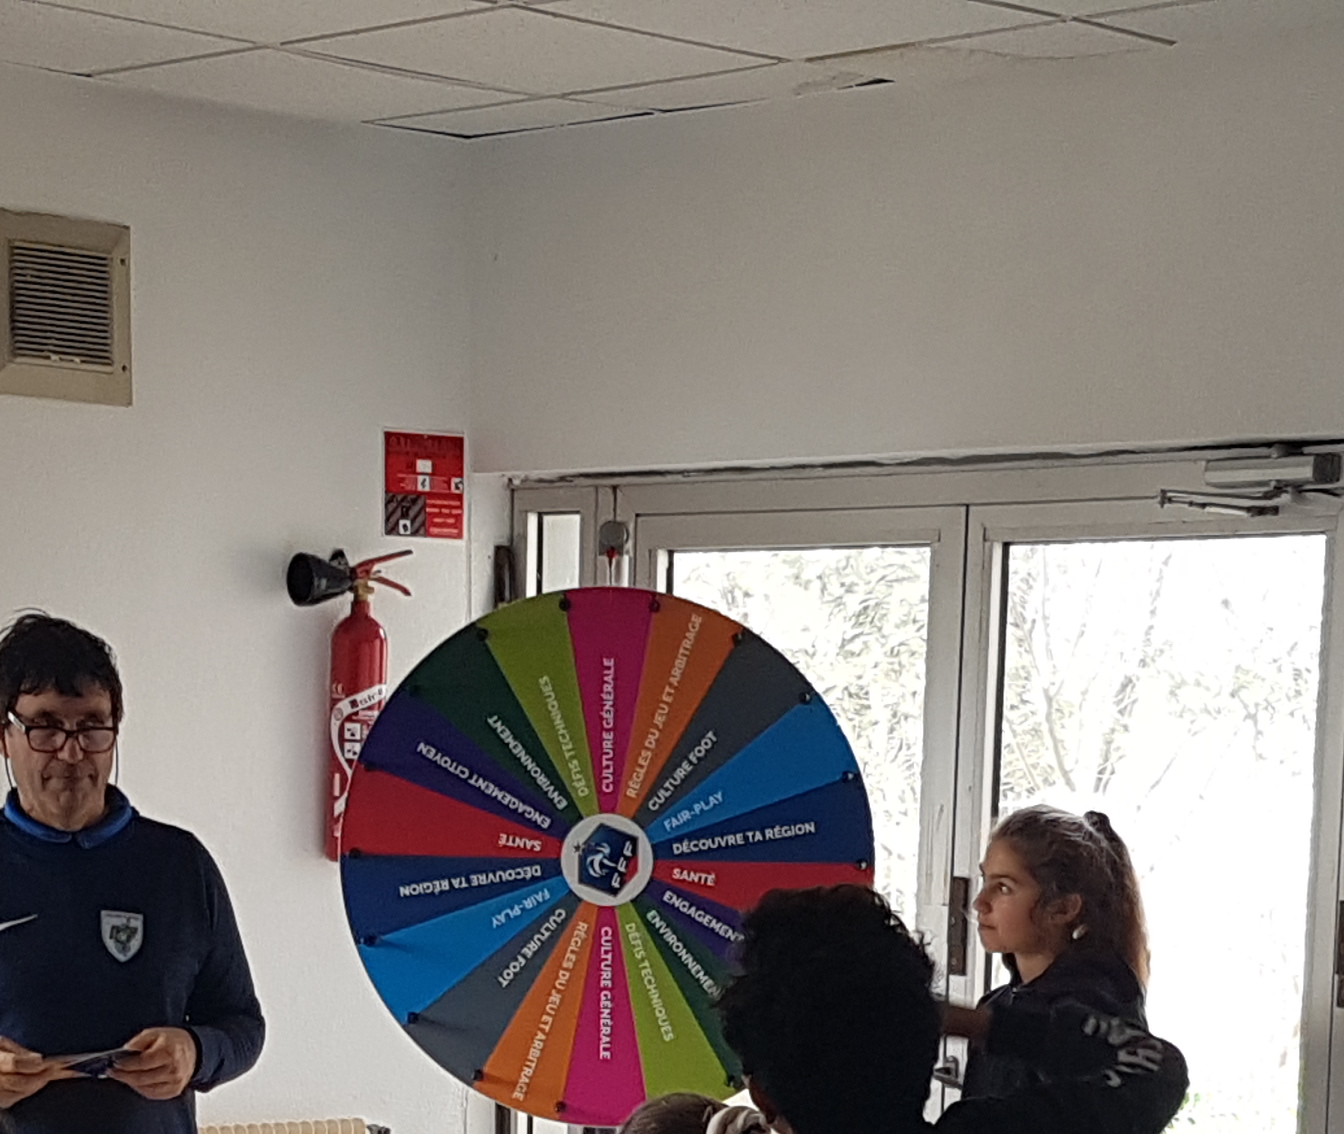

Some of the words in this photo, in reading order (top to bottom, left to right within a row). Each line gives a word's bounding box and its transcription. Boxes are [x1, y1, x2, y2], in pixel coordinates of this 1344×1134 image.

[668, 613, 702, 688] ARBITRAGE
[600, 658, 615, 728] GÉNÉRALE
[662, 684, 676, 702] ET
[538, 675, 573, 756] TECHNIQUES
[653, 702, 670, 731] JEU
[646, 727, 660, 749] DU
[416, 742, 470, 779] CITOYEN
[486, 714, 569, 811] ENVIRONNEMENT
[568, 757, 590, 798] DÉFIS
[601, 730, 614, 793] CULTURE
[626, 750, 652, 798] RÈGLES
[648, 760, 693, 811] CULTURE
[688, 730, 718, 765] FOOT
[467, 773, 552, 829] ENGAGEMENT
[663, 791, 724, 832] FAIR-PLAY
[497, 833, 543, 852] SANTÉ
[672, 831, 745, 855] DÉCOUVRE
[746, 830, 763, 843] TA
[765, 822, 816, 840] RÉGION
[399, 879, 450, 898] RÉGION
[451, 876, 470, 889] TA
[470, 864, 542, 888] DÉCOUVRE
[672, 868, 717, 887] SANTÉ
[491, 888, 551, 930] FAIR-PLAY
[520, 908, 567, 960] CULTURE
[646, 909, 725, 999] ENVIRONNEMEN
[496, 953, 526, 989] FOOT
[599, 926, 613, 988] CULTURE
[555, 970, 570, 991] DU
[625, 922, 644, 959] DÉFIS
[638, 958, 674, 1042] TECHNIQUES
[545, 988, 562, 1017] JEU
[539, 1016, 554, 1036] ET
[599, 989, 614, 1060] GÉNÉRALE
[511, 1032, 546, 1101] ARBITRAGE
